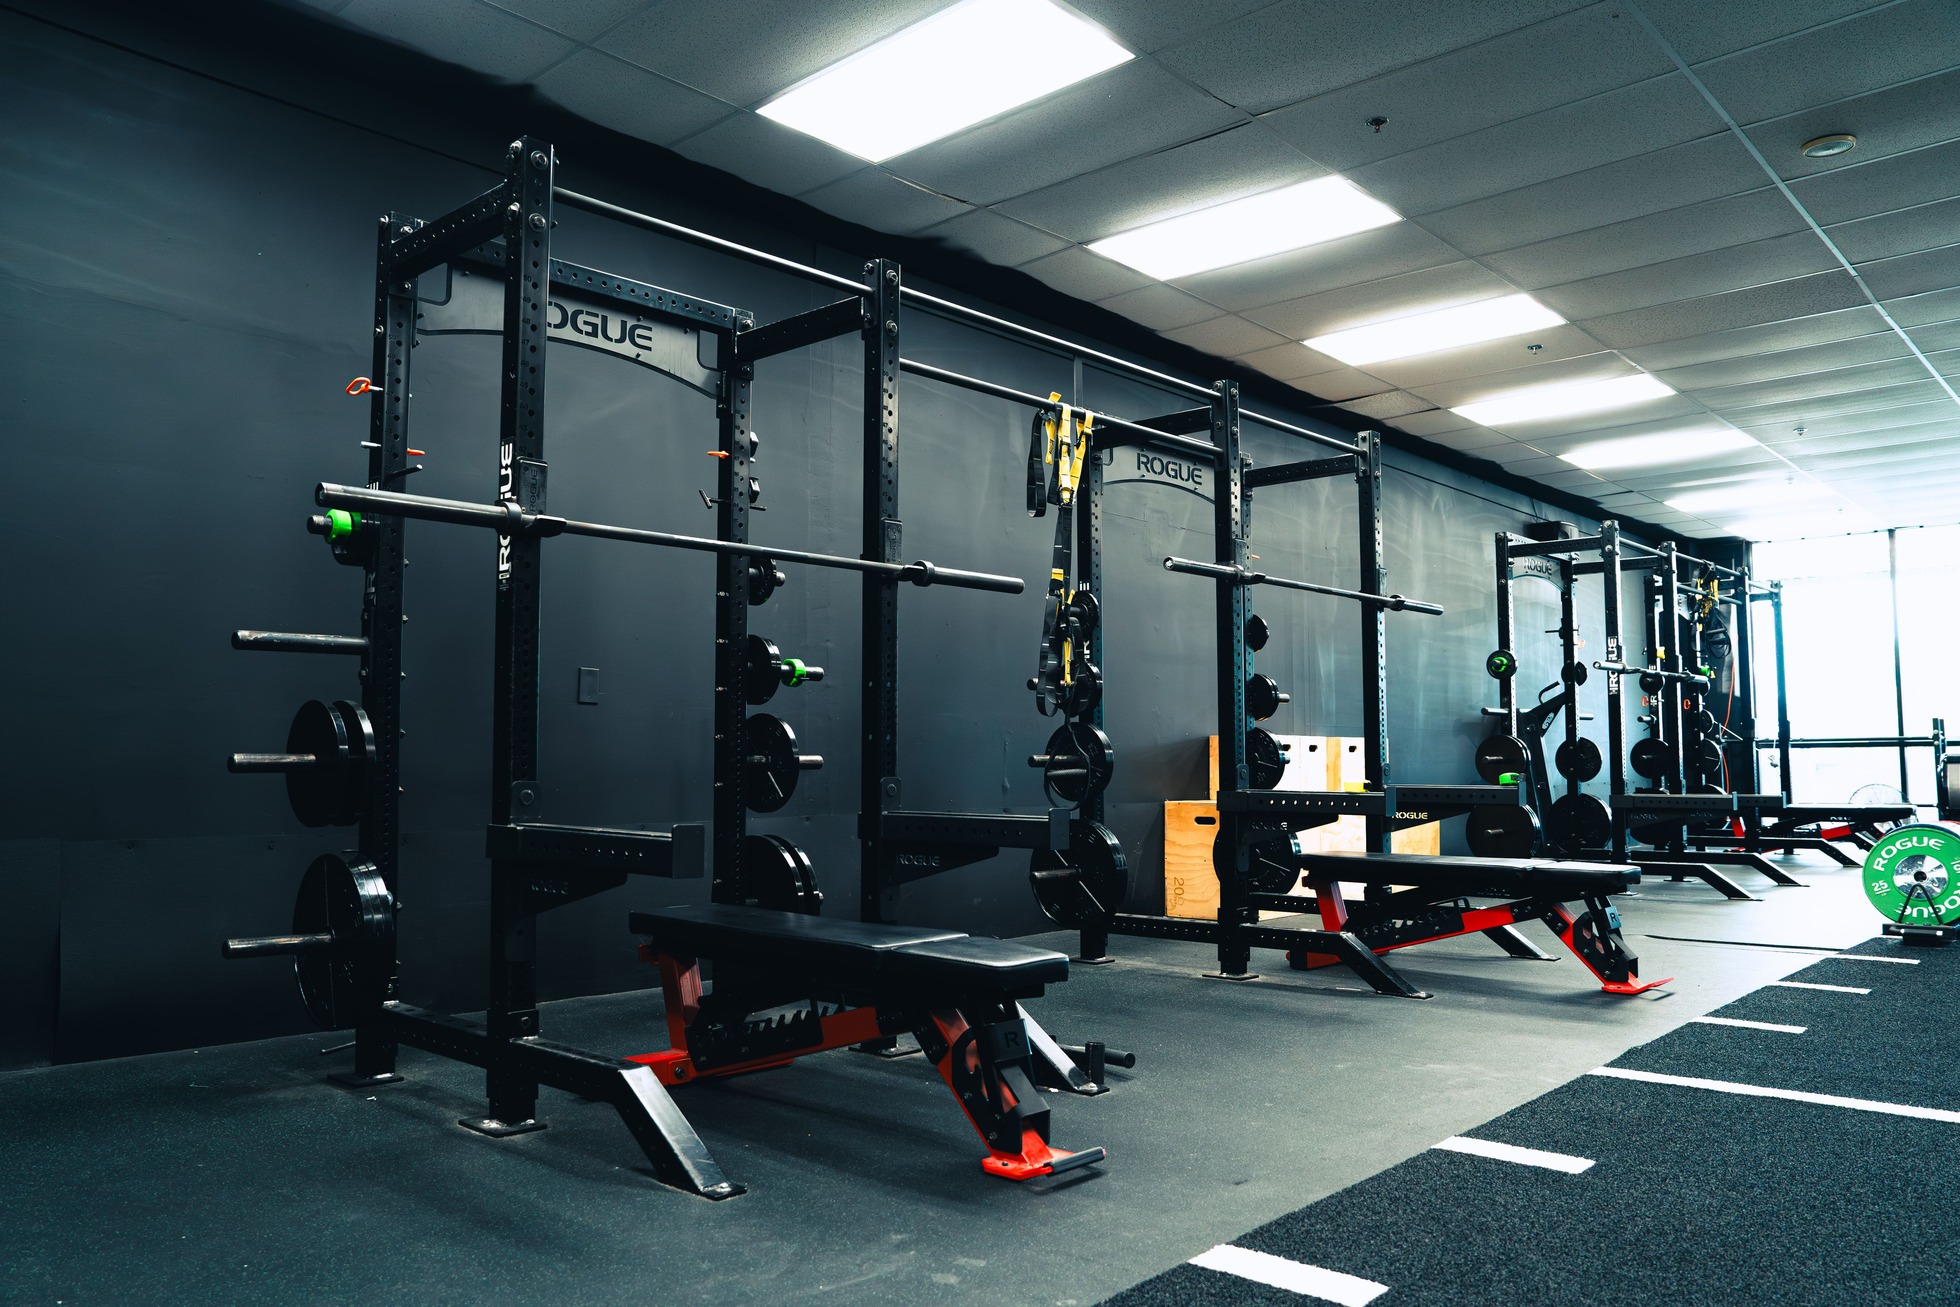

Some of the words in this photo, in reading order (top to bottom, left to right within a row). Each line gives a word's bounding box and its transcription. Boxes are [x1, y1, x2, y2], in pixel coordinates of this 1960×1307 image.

[548, 301, 652, 351] OGUE
[1136, 453, 1202, 485] ROGUE
[529, 469, 537, 512] ROGUE
[499, 442, 513, 572] RUE
[896, 853, 940, 867] ROGUE
[1873, 836, 1945, 871] ROGUE
[1174, 877, 1184, 896] 20
[1872, 880, 1888, 892] 25
[1610, 912, 1617, 922] R
[1004, 1031, 1020, 1049] R
